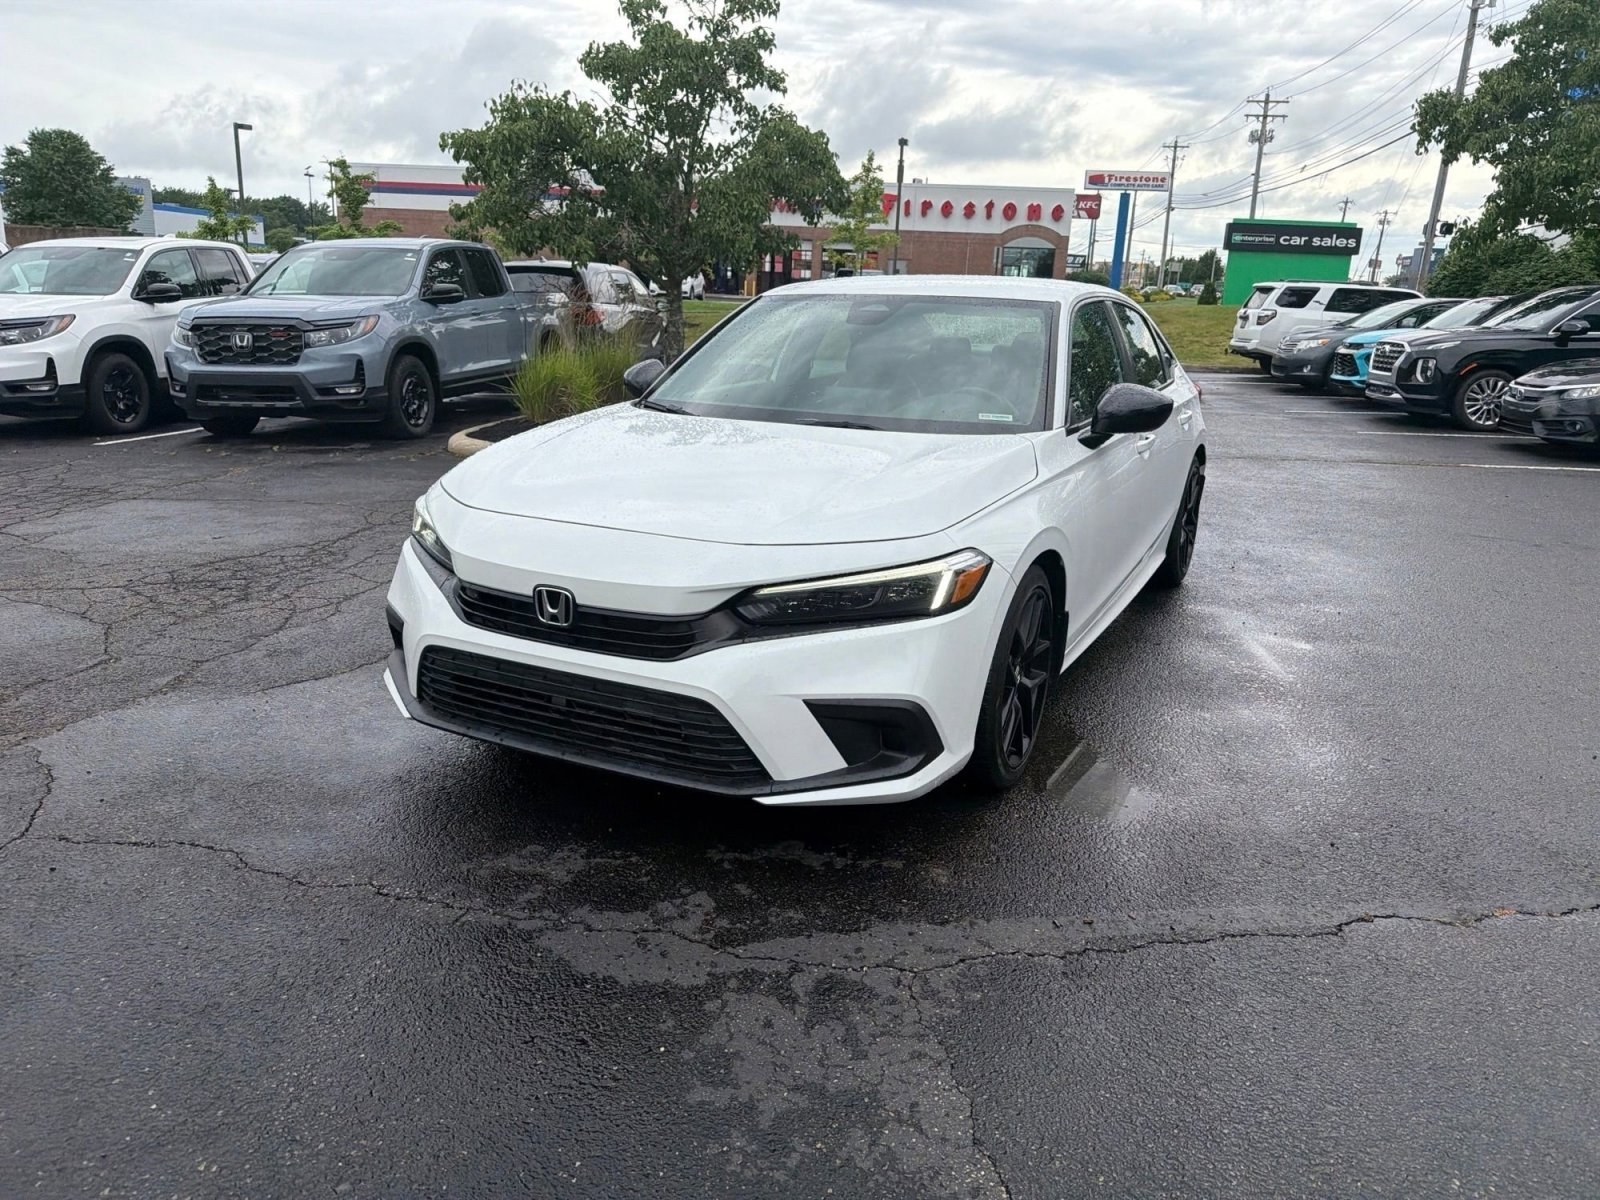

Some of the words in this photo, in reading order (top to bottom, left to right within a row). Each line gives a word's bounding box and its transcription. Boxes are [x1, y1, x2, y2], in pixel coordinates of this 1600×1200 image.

[1107, 174, 1167, 183] Firestone
[880, 193, 1065, 222] Firestone
[1078, 201, 1099, 209] KFC
[1279, 235, 1309, 246] car
[1311, 233, 1357, 248] sales
